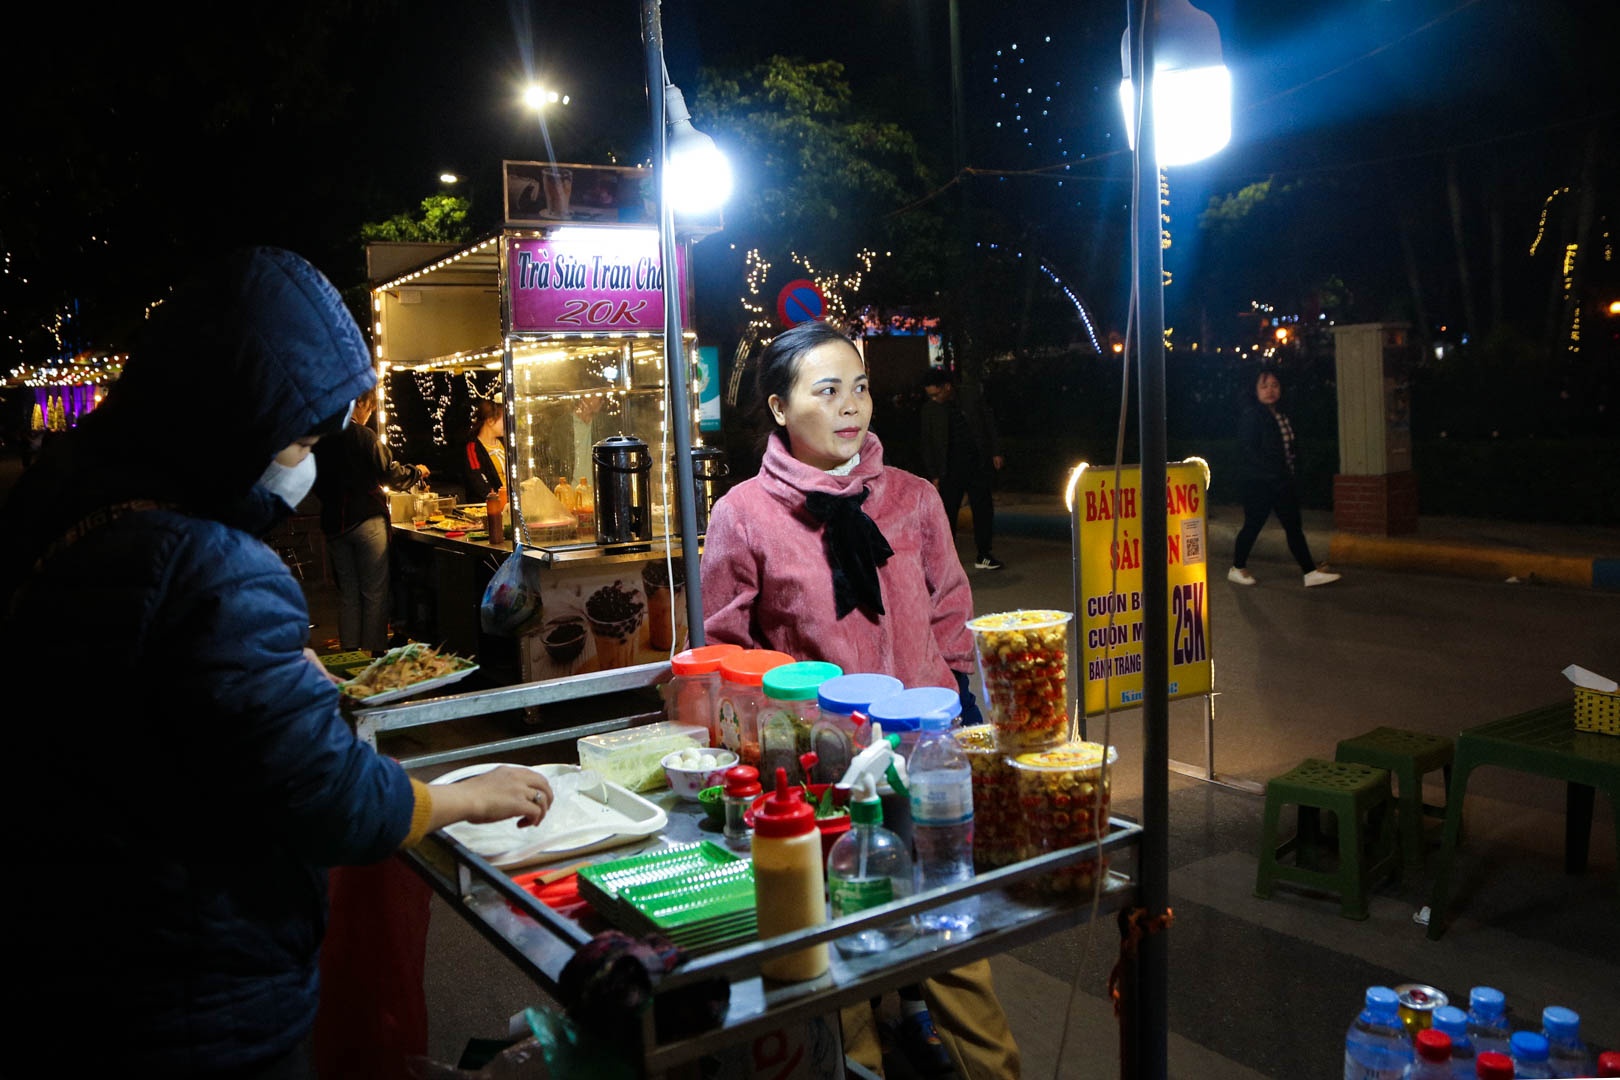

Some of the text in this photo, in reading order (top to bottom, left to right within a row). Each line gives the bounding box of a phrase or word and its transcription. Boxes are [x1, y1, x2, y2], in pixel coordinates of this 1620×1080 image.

[518, 250, 550, 289] Trà
[556, 300, 647, 326] 20K
[1085, 480, 1137, 522] BÁNH
[1110, 530, 1141, 571] SÀI
[1088, 623, 1128, 650] CUỘN
[1172, 582, 1206, 666] 25K
[1089, 652, 1142, 681] BÁNH TRÁNG
